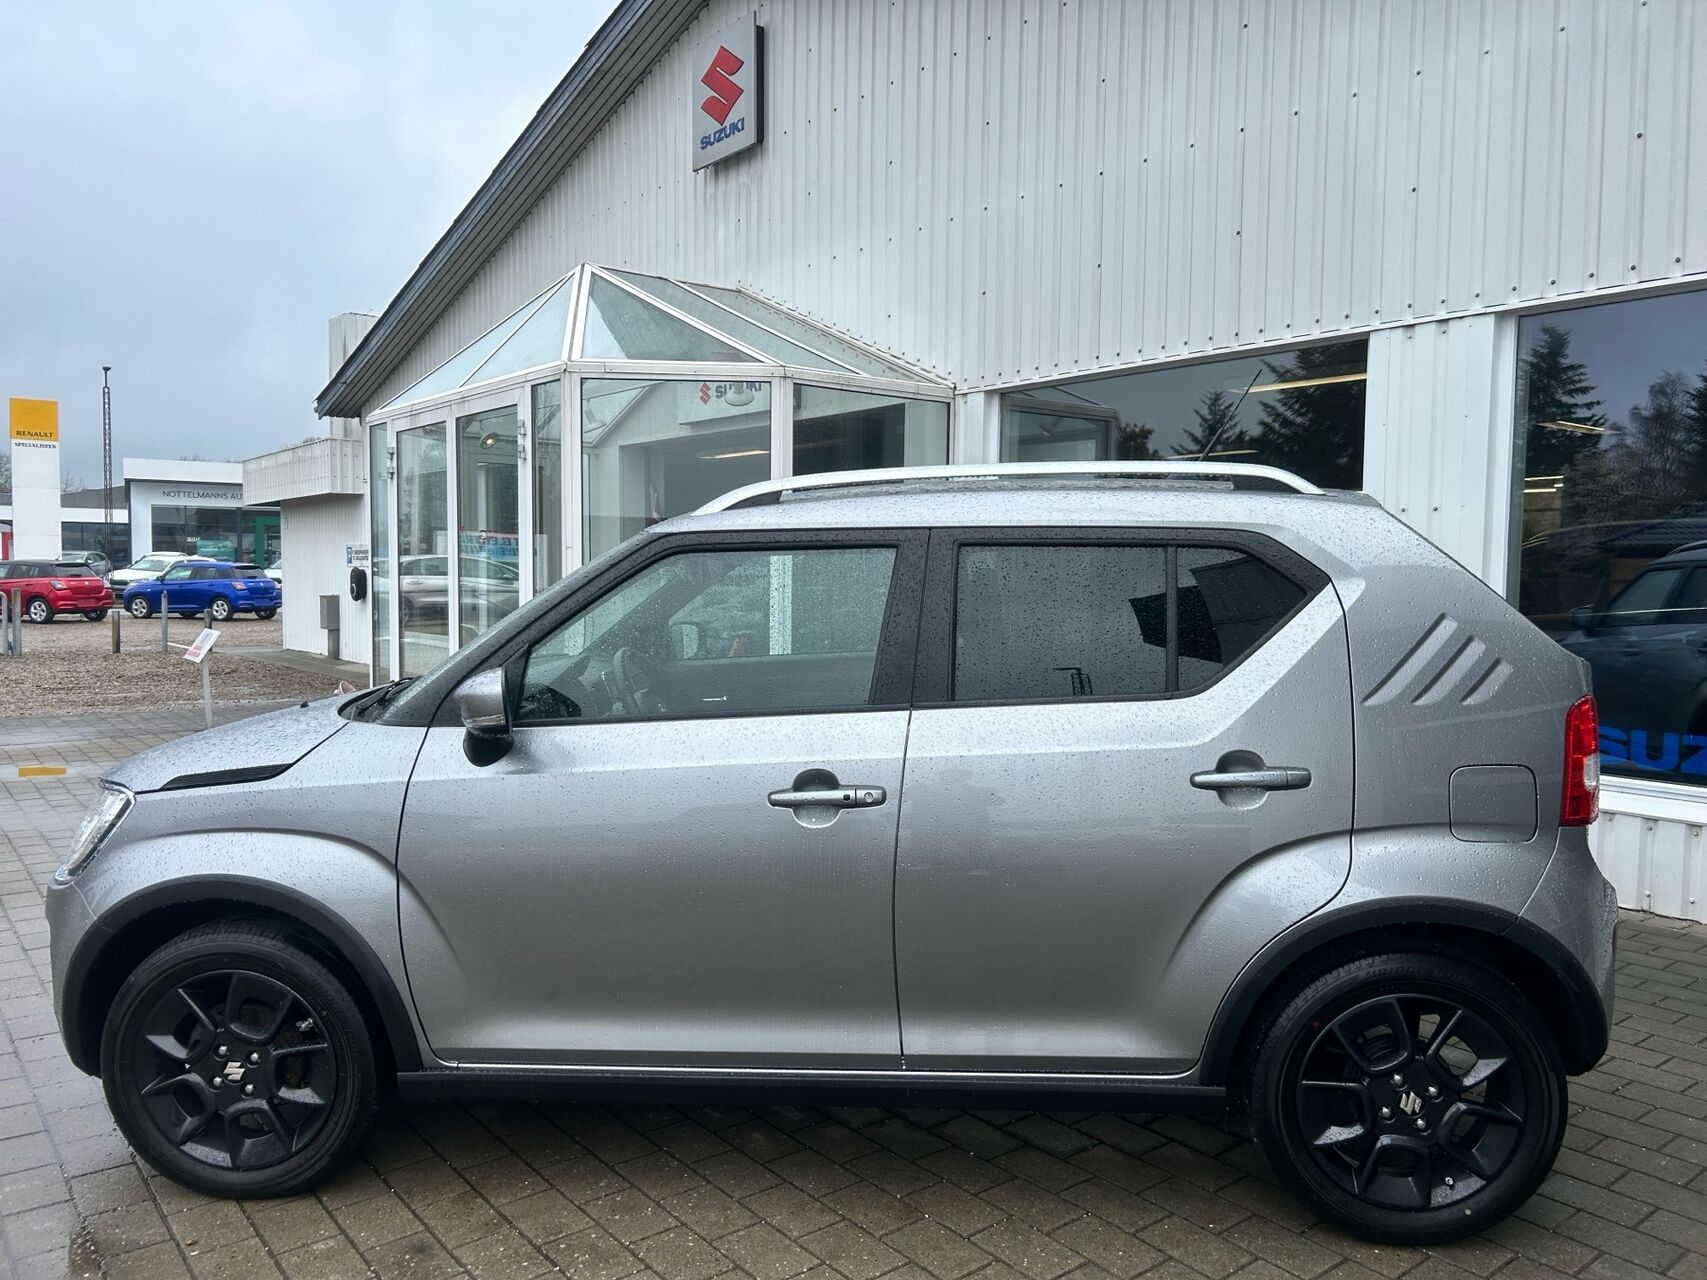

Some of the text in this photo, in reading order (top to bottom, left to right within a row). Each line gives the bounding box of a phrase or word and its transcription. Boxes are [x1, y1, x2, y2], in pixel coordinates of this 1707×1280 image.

[700, 117, 745, 150] SUZUKI
[715, 382, 762, 399] SUKI
[16, 430, 53, 438] RENAULT
[162, 490, 228, 500] NOTTELMANNS
